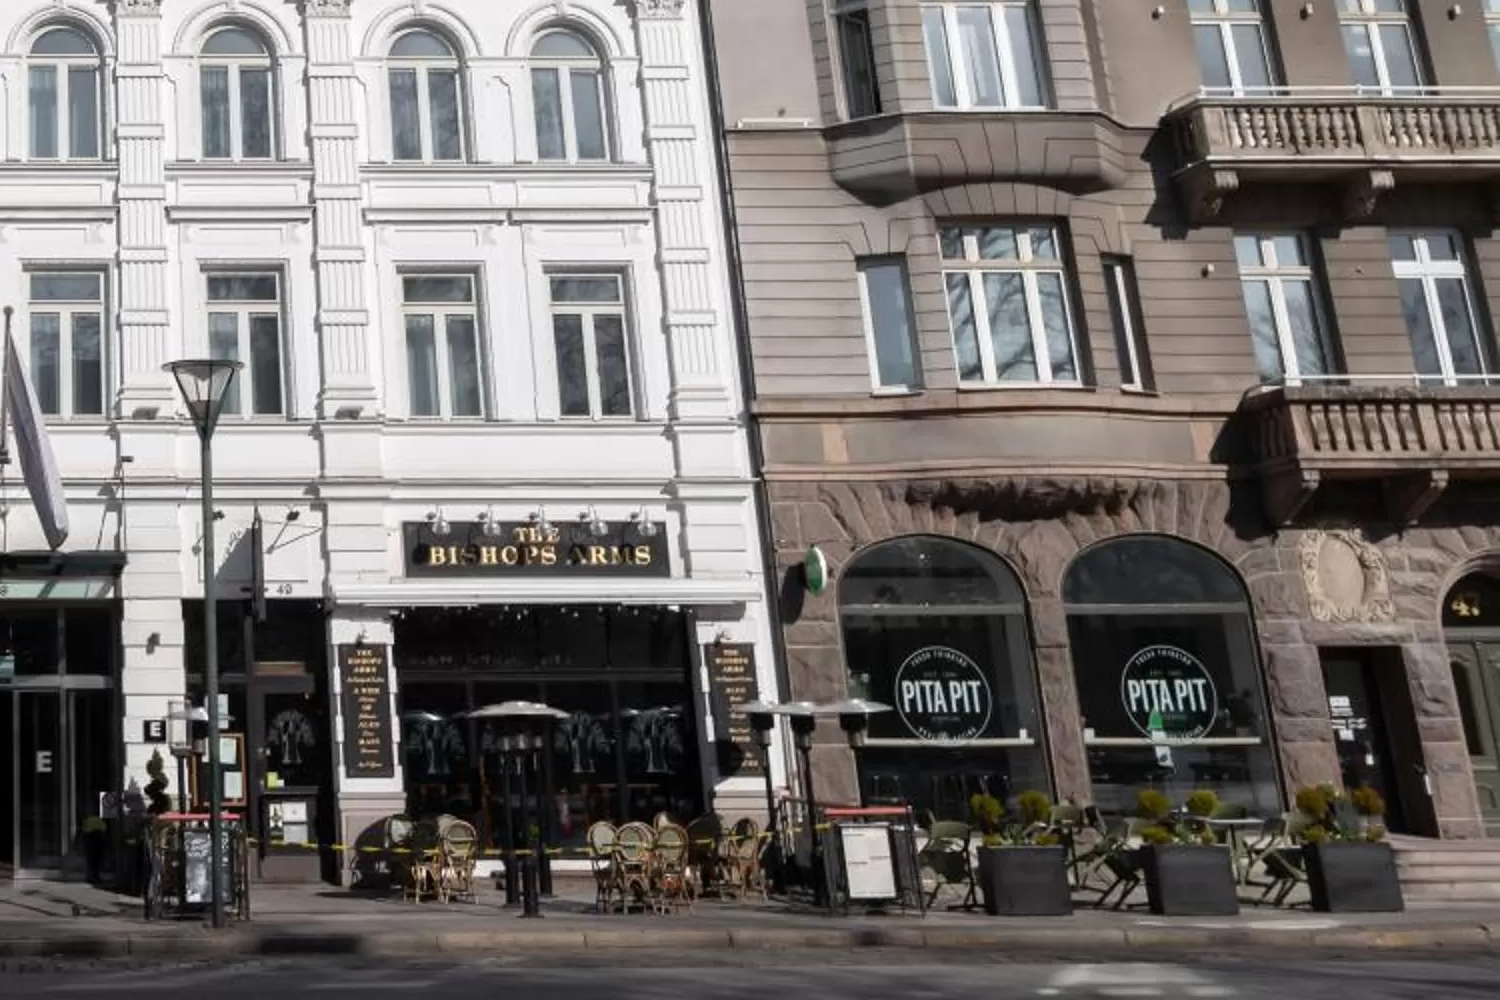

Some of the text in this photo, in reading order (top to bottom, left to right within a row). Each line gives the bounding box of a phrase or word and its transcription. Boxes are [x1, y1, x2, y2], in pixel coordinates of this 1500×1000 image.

[514, 526, 561, 543] THE
[429, 545, 651, 566] BISHOPS ARMS
[901, 679, 981, 713] PITA PIT
[1127, 679, 1207, 713] PITA PIT
[150, 722, 162, 737] E
[35, 751, 53, 773] E
